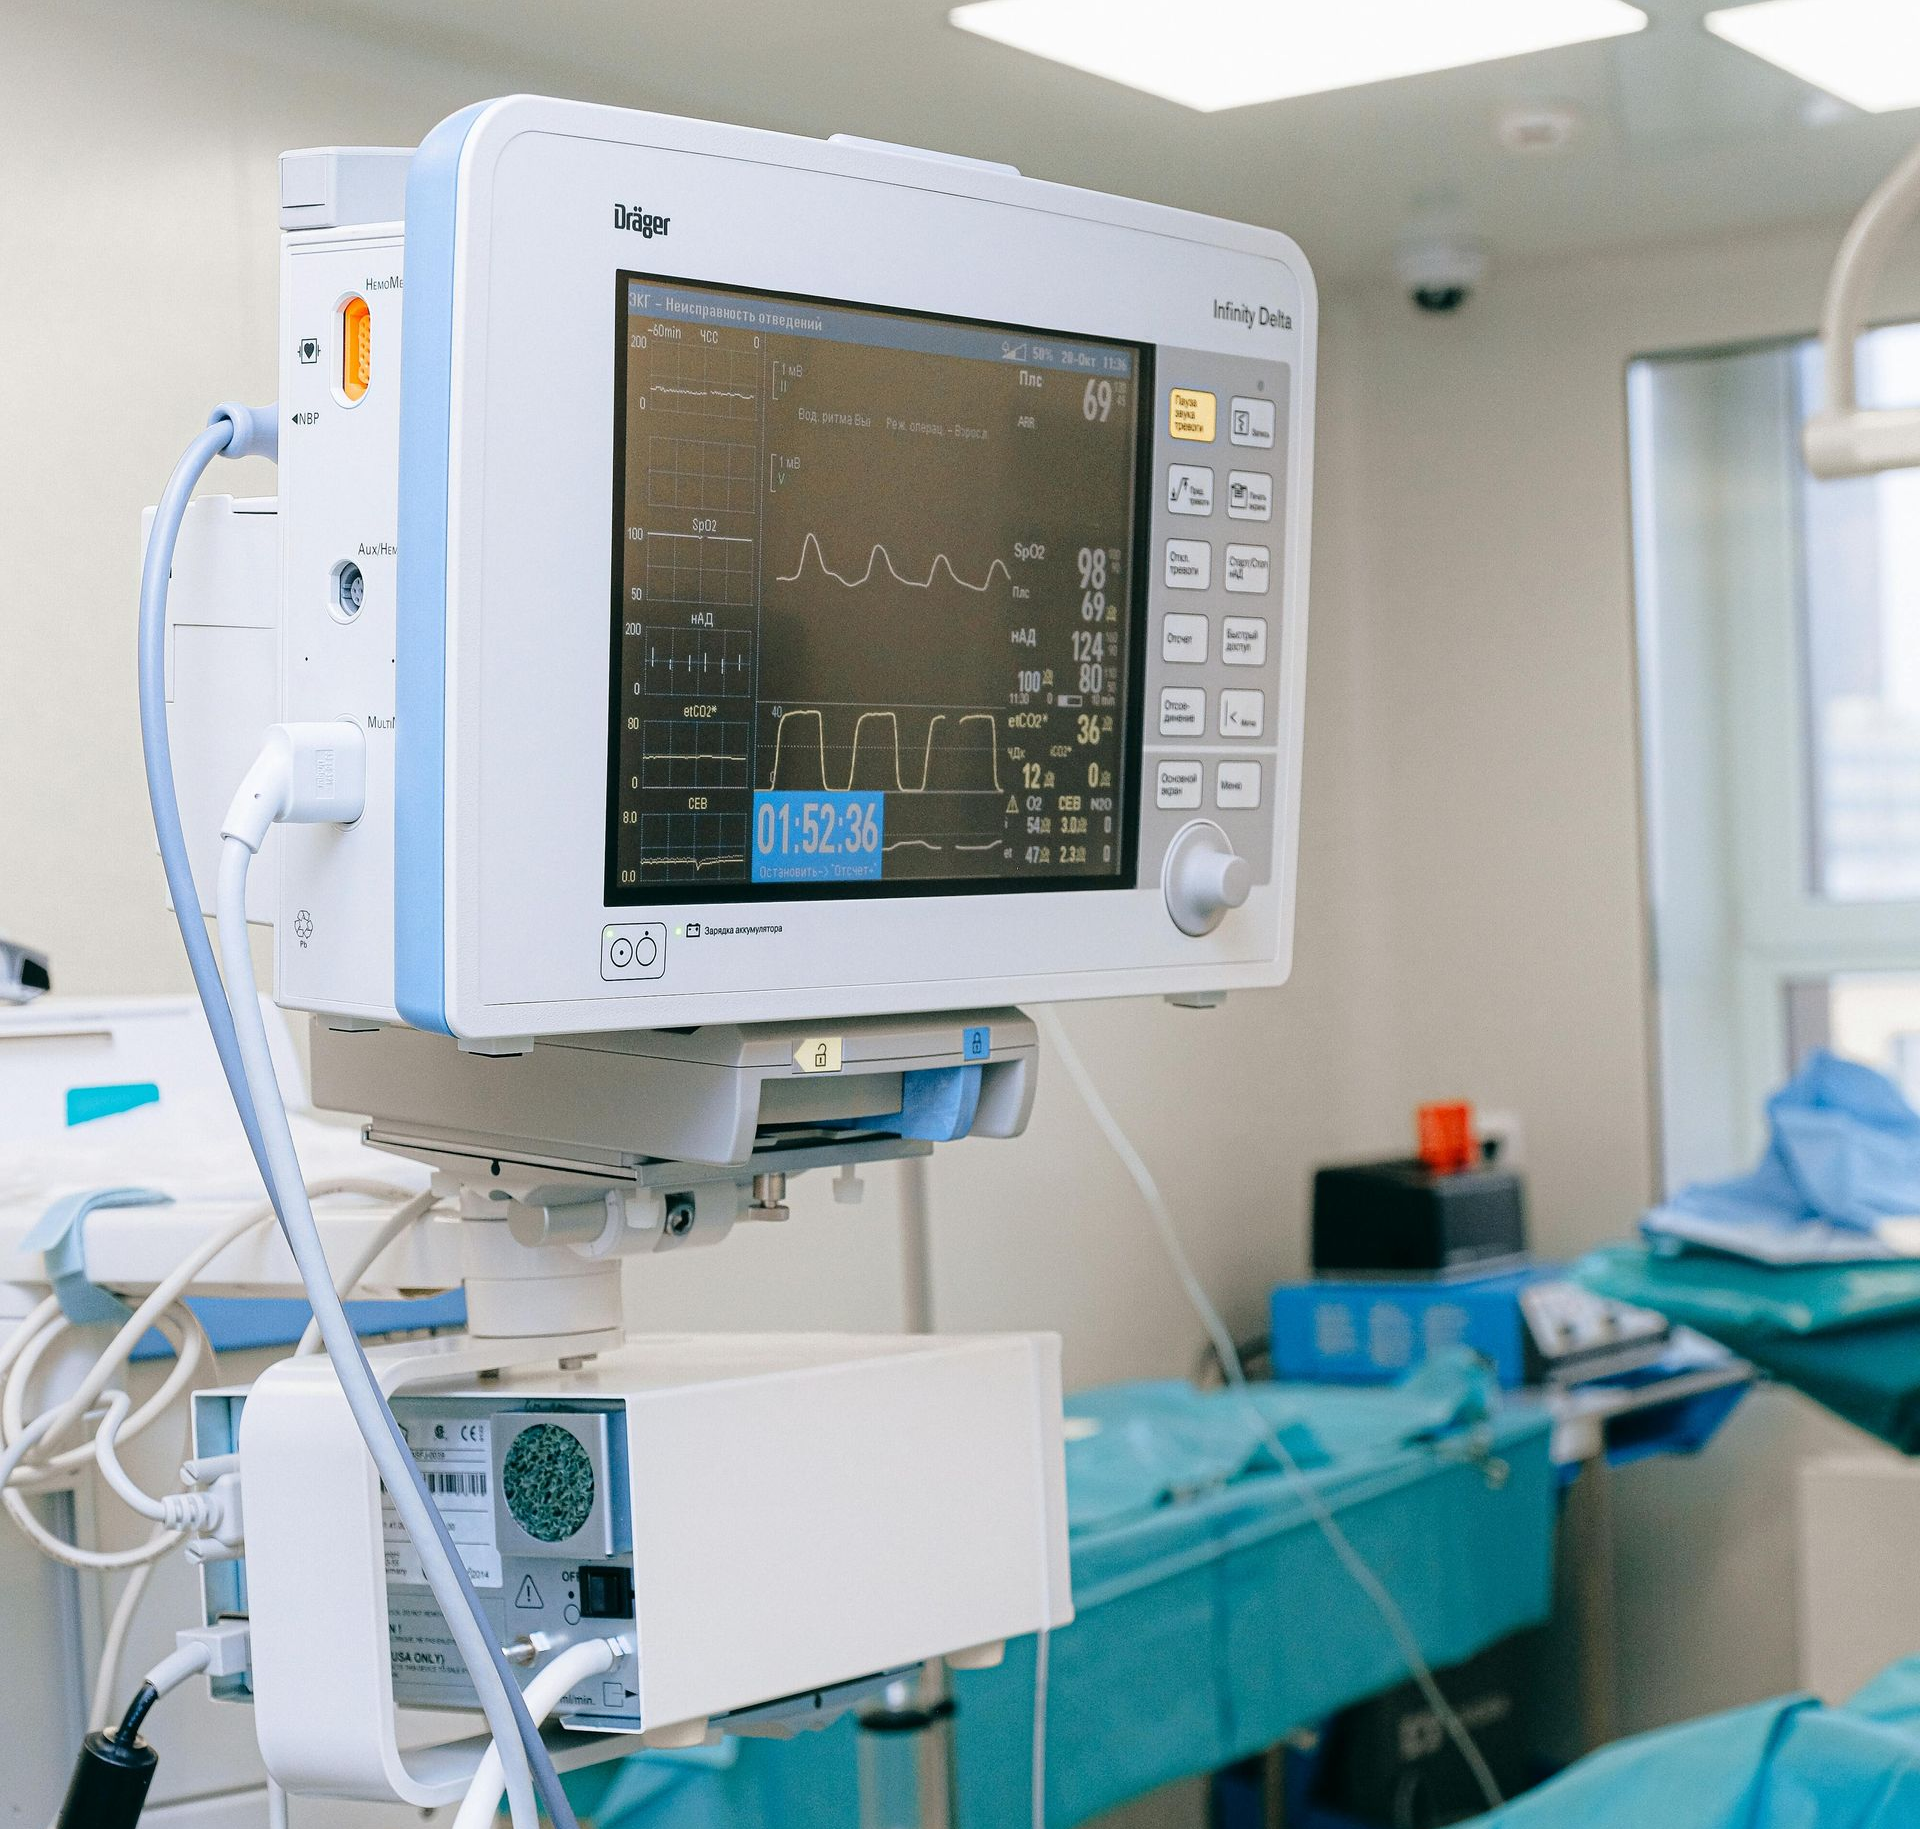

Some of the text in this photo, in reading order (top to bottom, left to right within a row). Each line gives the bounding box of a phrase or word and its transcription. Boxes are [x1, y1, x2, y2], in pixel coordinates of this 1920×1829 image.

[614, 203, 671, 239] Dräger
[628, 292, 650, 308] ЭКГ
[666, 297, 755, 323] Неисправность
[759, 314, 822, 331] отведений
[1213, 299, 1292, 329] Infinity Delta
[630, 335, 647, 349] 200
[700, 329, 719, 344] ЧСС
[754, 336, 760, 349] 0
[1019, 370, 1043, 387] Плс
[639, 397, 646, 410] 0
[1082, 379, 1112, 422] 69
[1175, 395, 1198, 409] Пауза
[299, 412, 320, 425] NBP
[1174, 410, 1196, 421] звука
[1174, 421, 1204, 433] тревоги
[627, 527, 644, 540] 100
[692, 518, 717, 533] SpO2
[1014, 542, 1046, 561] SpO2
[1077, 547, 1106, 590] 98
[631, 588, 643, 601] 50
[1012, 586, 1030, 599] Плс
[1081, 590, 1105, 622] 69
[691, 612, 715, 628] нАД
[625, 623, 642, 636] 200
[1010, 628, 1037, 648] нАД
[1071, 630, 1104, 662] 124
[1017, 670, 1041, 693] 100
[1078, 663, 1103, 694] 80
[633, 683, 641, 695] 0
[627, 717, 640, 730] 80
[1077, 714, 1100, 745] 36
[631, 776, 638, 789] 0
[1022, 762, 1042, 789] 12
[1088, 762, 1099, 788] 0
[1026, 795, 1043, 812] O2
[622, 811, 638, 824] 8.0
[1026, 816, 1041, 834] 54
[1104, 816, 1112, 834] 0
[757, 803, 879, 855] 01:52:36
[1024, 846, 1040, 864] 47
[1059, 845, 1077, 864] 2.3
[1103, 845, 1111, 863] 0
[621, 870, 637, 883] 0.0
[704, 924, 783, 936] Зарядка аккумулятора
[300, 940, 308, 949] Pb
